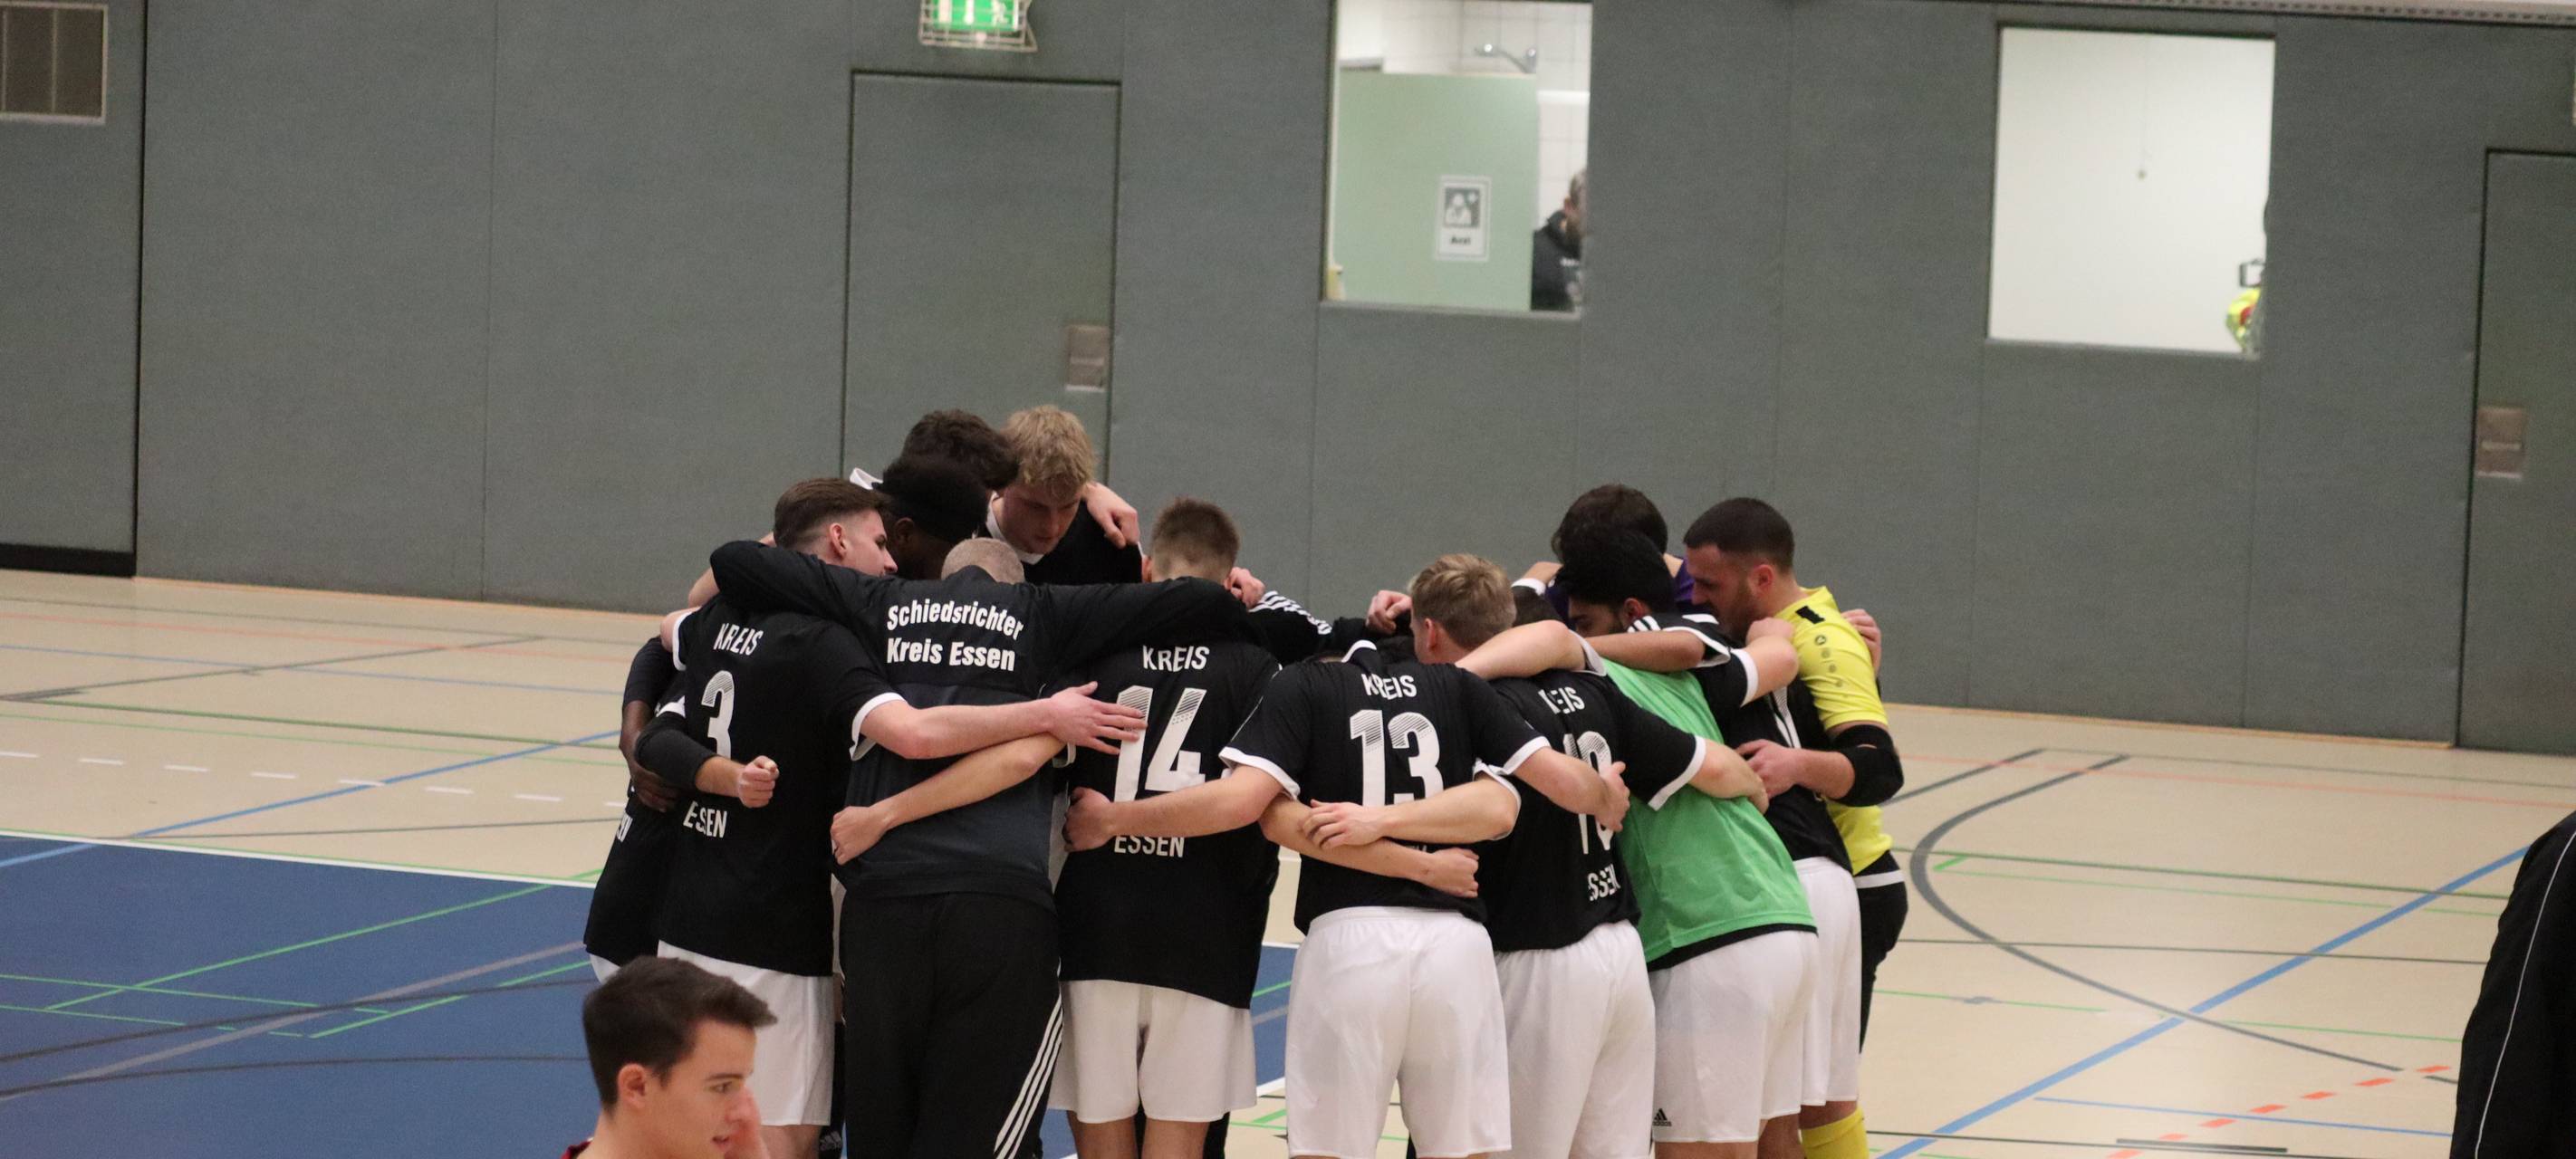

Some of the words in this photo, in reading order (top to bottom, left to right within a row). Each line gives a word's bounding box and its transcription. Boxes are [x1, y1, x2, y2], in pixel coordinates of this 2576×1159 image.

[887, 598, 1024, 641] Schiedsrichter
[713, 622, 764, 656] KREIS
[887, 637, 944, 665] Kreis
[948, 641, 1016, 672] Essen
[1142, 645, 1210, 673] KREIS
[1360, 673, 1418, 700] KREIS
[700, 670, 735, 760] 3
[1114, 685, 1206, 802] 14
[1350, 709, 1444, 808] 13
[1113, 834, 1186, 858] ESSEN
